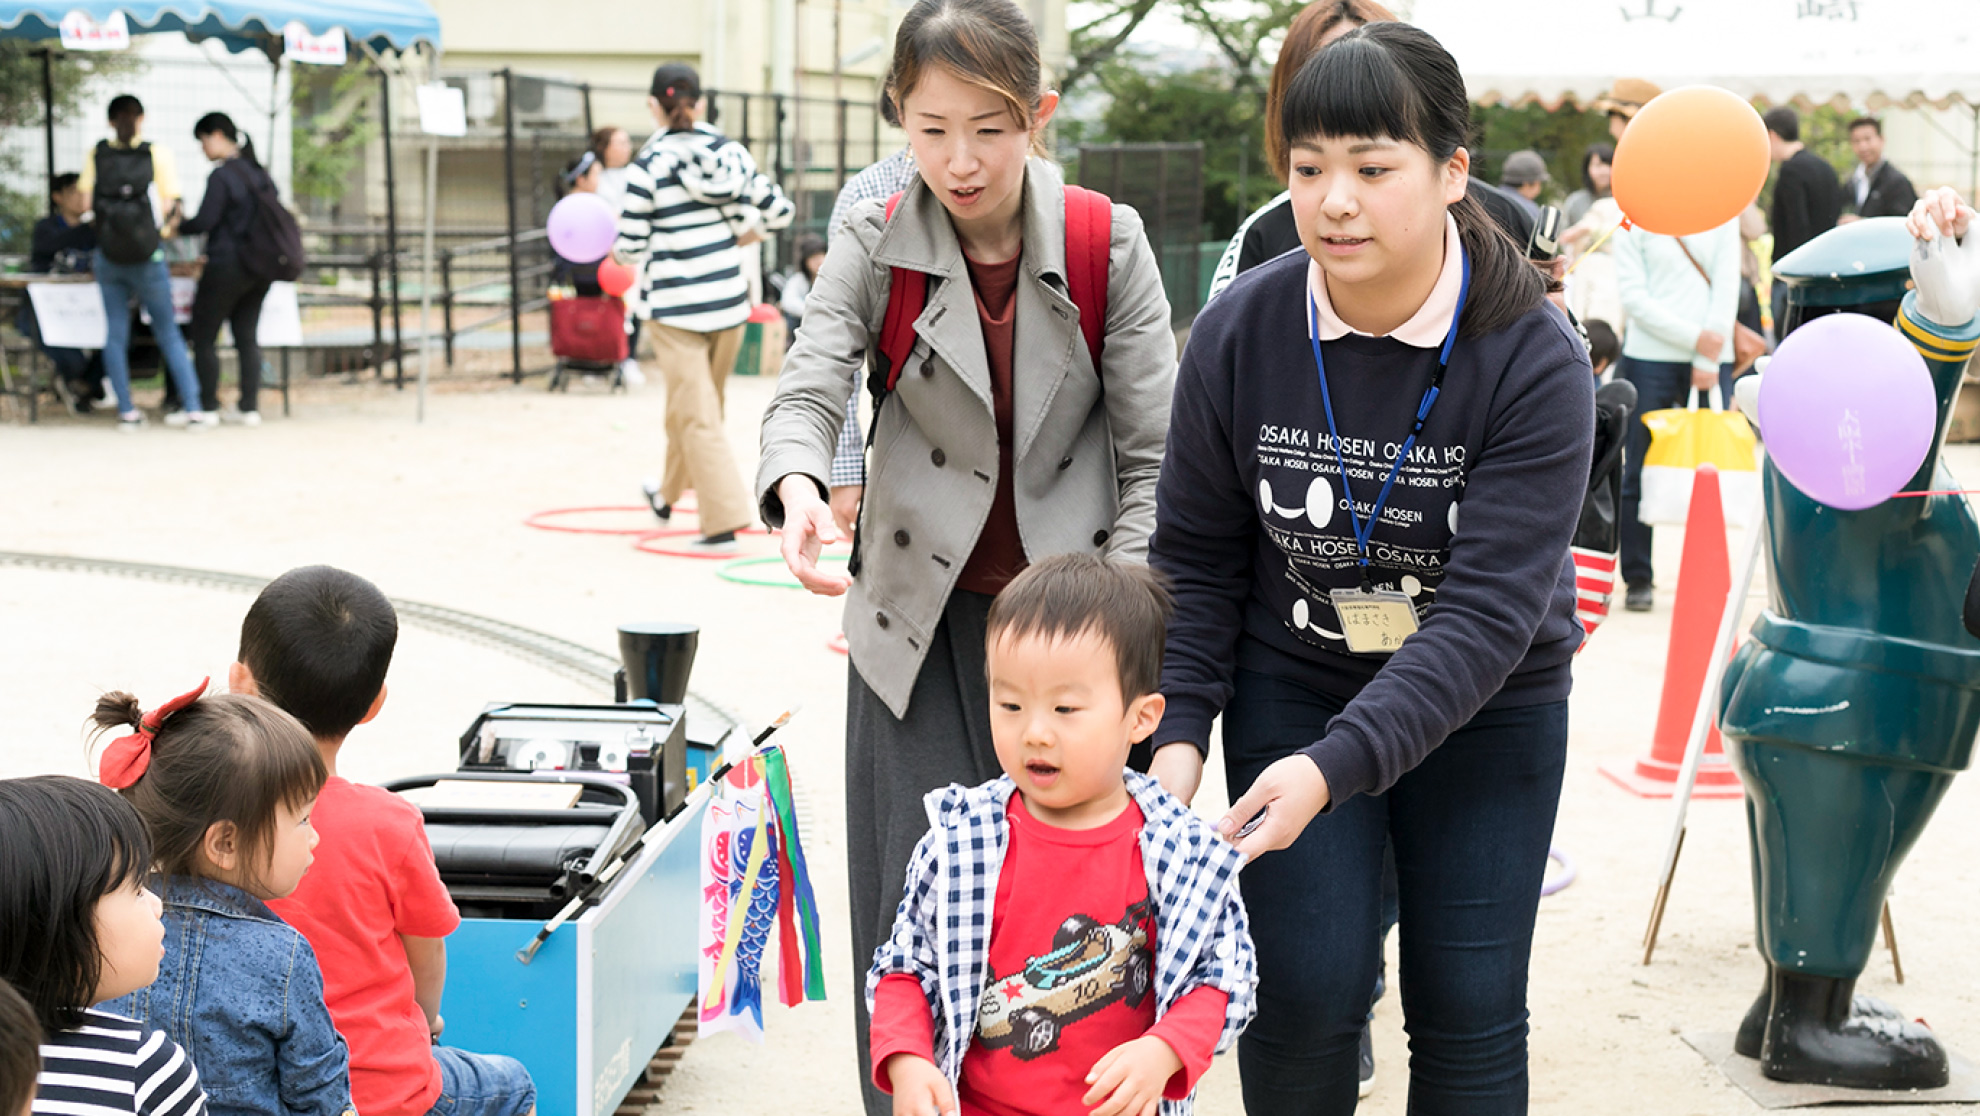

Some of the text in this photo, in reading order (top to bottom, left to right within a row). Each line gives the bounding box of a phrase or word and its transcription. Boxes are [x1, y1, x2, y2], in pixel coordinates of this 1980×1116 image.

[1259, 424, 1310, 448] OSAKA
[1317, 431, 1375, 457] HOSEN
[1283, 458, 1309, 470] HOSEN
[1311, 462, 1342, 475] OSAKA
[1345, 467, 1374, 480] HOSEN
[1409, 477, 1438, 488] HOSEN
[1384, 506, 1422, 523] HOSEN
[1376, 547, 1441, 567] OSAKA
[1074, 978, 1099, 1004] 10
